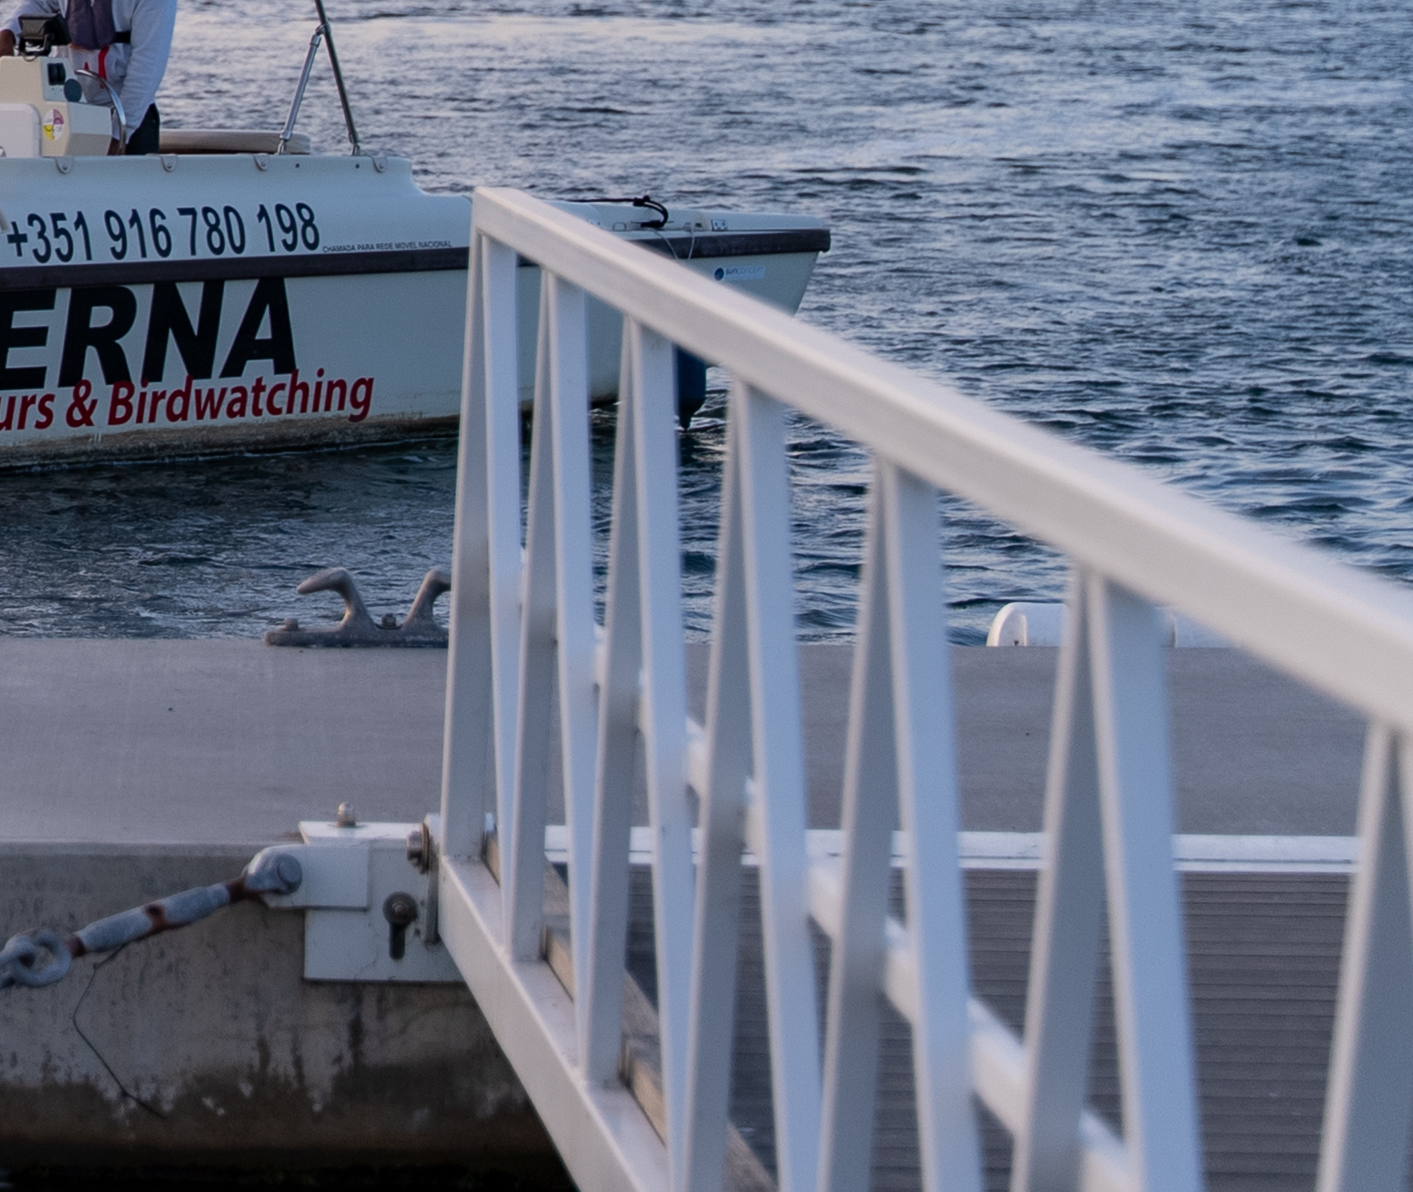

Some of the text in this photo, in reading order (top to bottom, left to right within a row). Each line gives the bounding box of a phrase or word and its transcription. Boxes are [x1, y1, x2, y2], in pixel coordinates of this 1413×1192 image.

[7, 210, 93, 263] +351
[103, 207, 172, 261] 916
[176, 205, 246, 256] 780
[256, 202, 320, 253] 198
[322, 244, 356, 253] CHAMADA
[357, 243, 375, 251] PARA
[376, 242, 394, 250] REDE
[65, 379, 98, 428] &
[107, 367, 375, 426] Birdwatching
